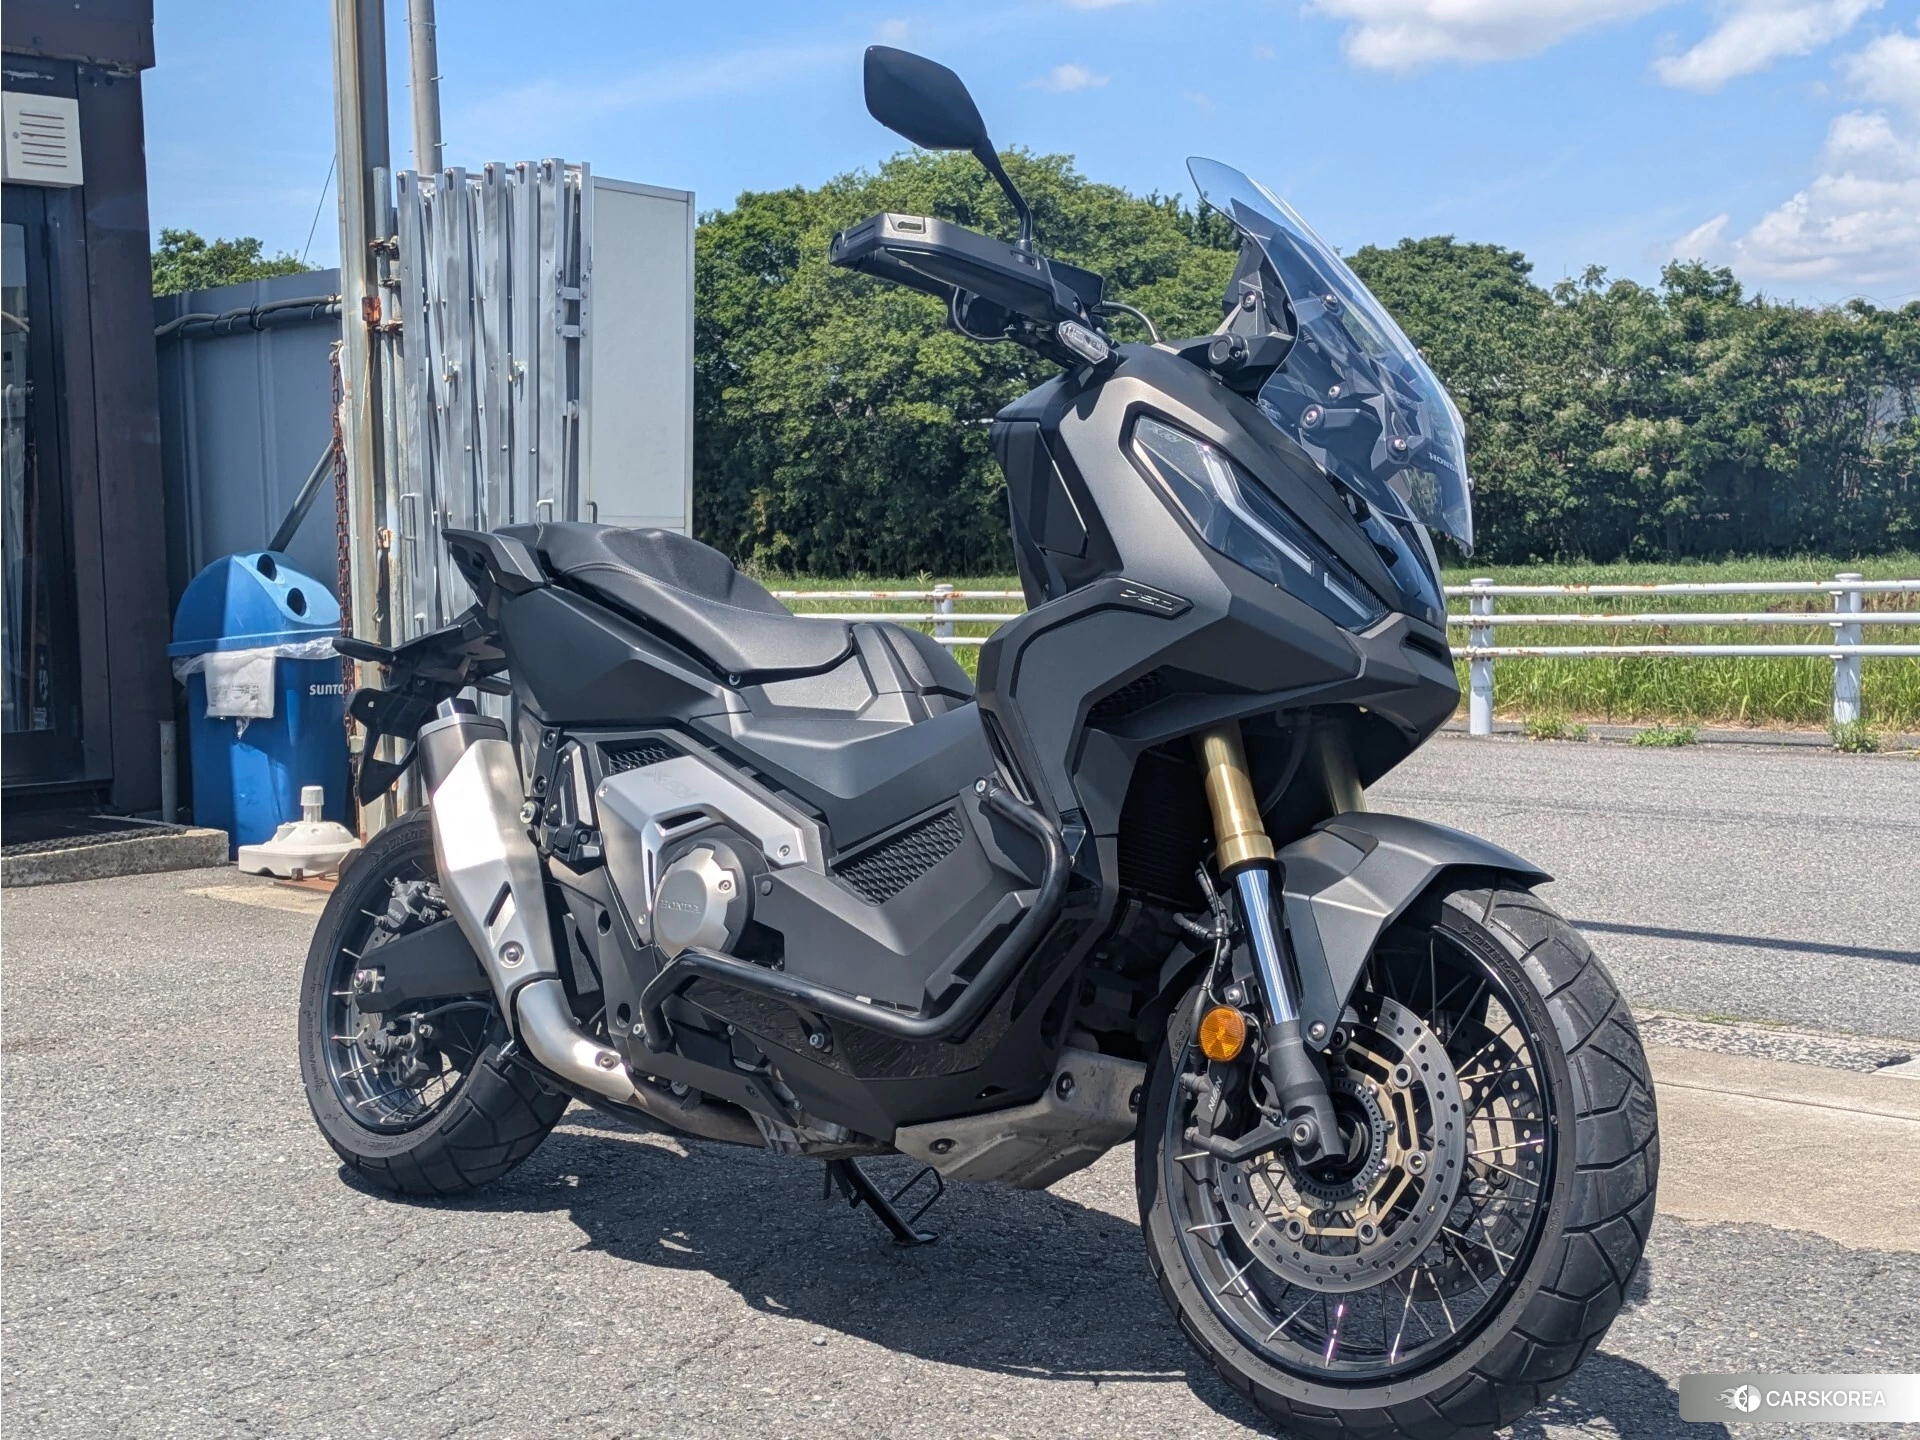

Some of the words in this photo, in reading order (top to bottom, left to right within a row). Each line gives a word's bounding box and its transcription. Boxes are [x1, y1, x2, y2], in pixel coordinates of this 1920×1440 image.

[309, 683, 354, 696] SUNTO
[660, 900, 701, 914] HONDA
[1471, 931, 1530, 999] DUNLOP
